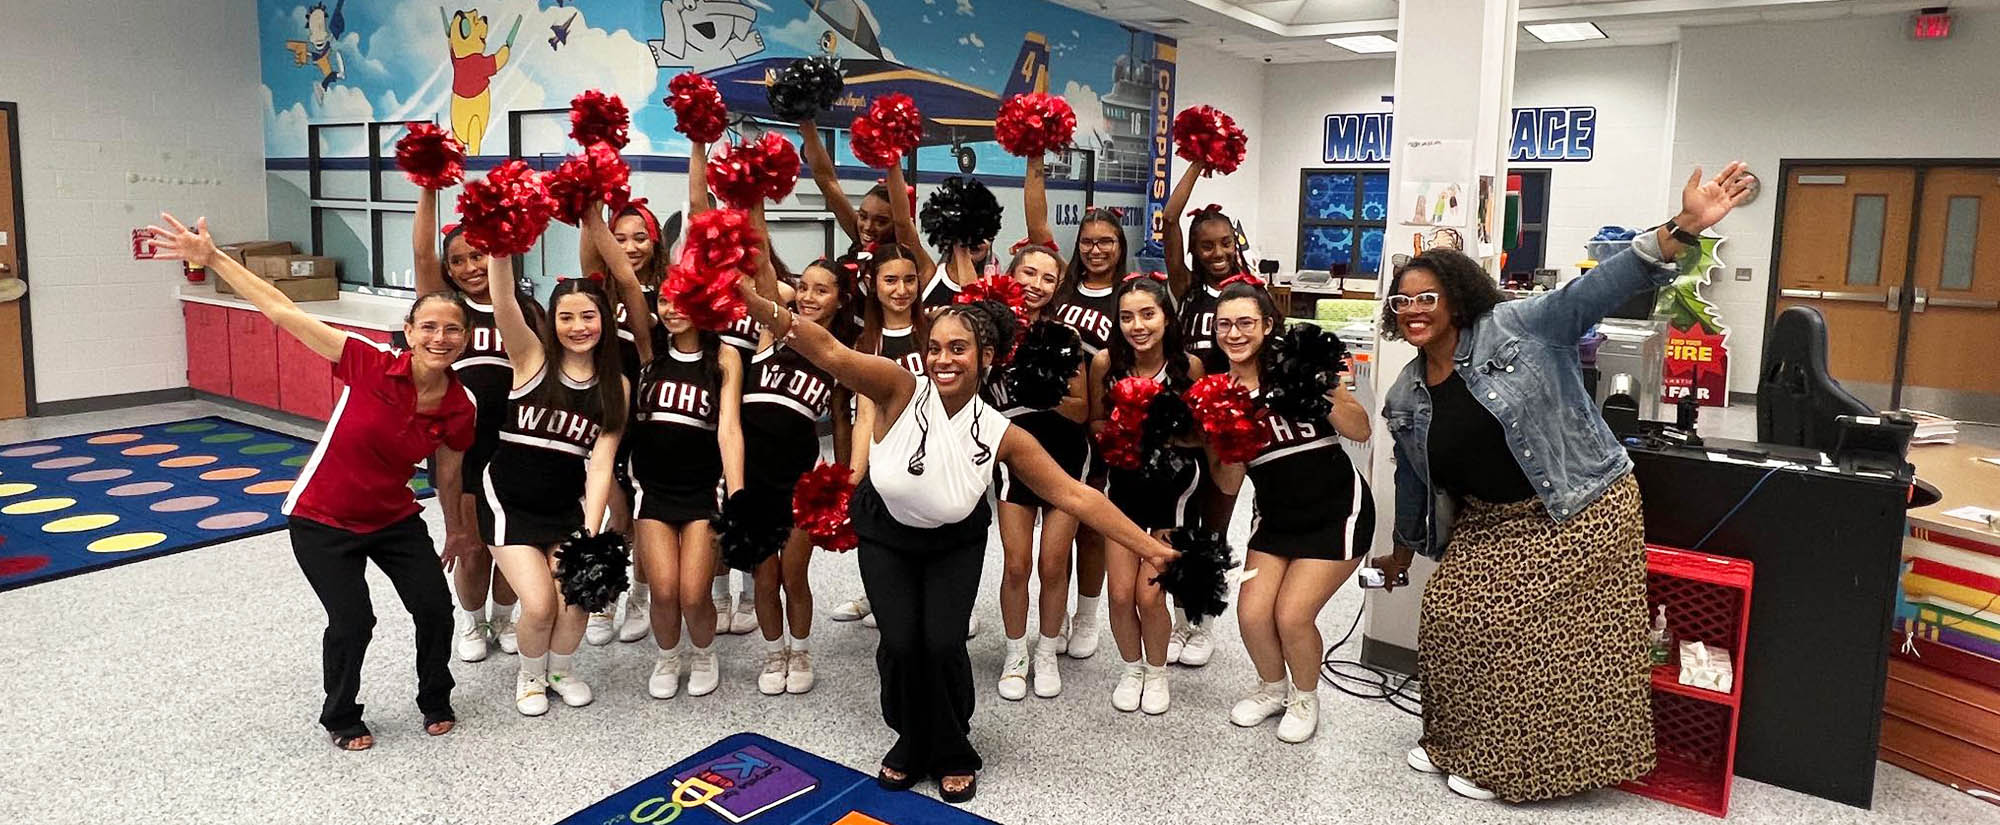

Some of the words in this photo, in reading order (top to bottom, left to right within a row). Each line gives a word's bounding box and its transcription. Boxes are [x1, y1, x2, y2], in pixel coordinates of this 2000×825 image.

[1022, 51, 1036, 83] 4
[1153, 68, 1170, 200] CORPUS
[1510, 108, 1596, 161] ACE
[1055, 204, 1080, 226] U.S.S.
[1664, 346, 1712, 361] FIRE
[1668, 386, 1710, 399] FAR
[517, 405, 600, 445] WOHS
[629, 752, 771, 825] KIDS
